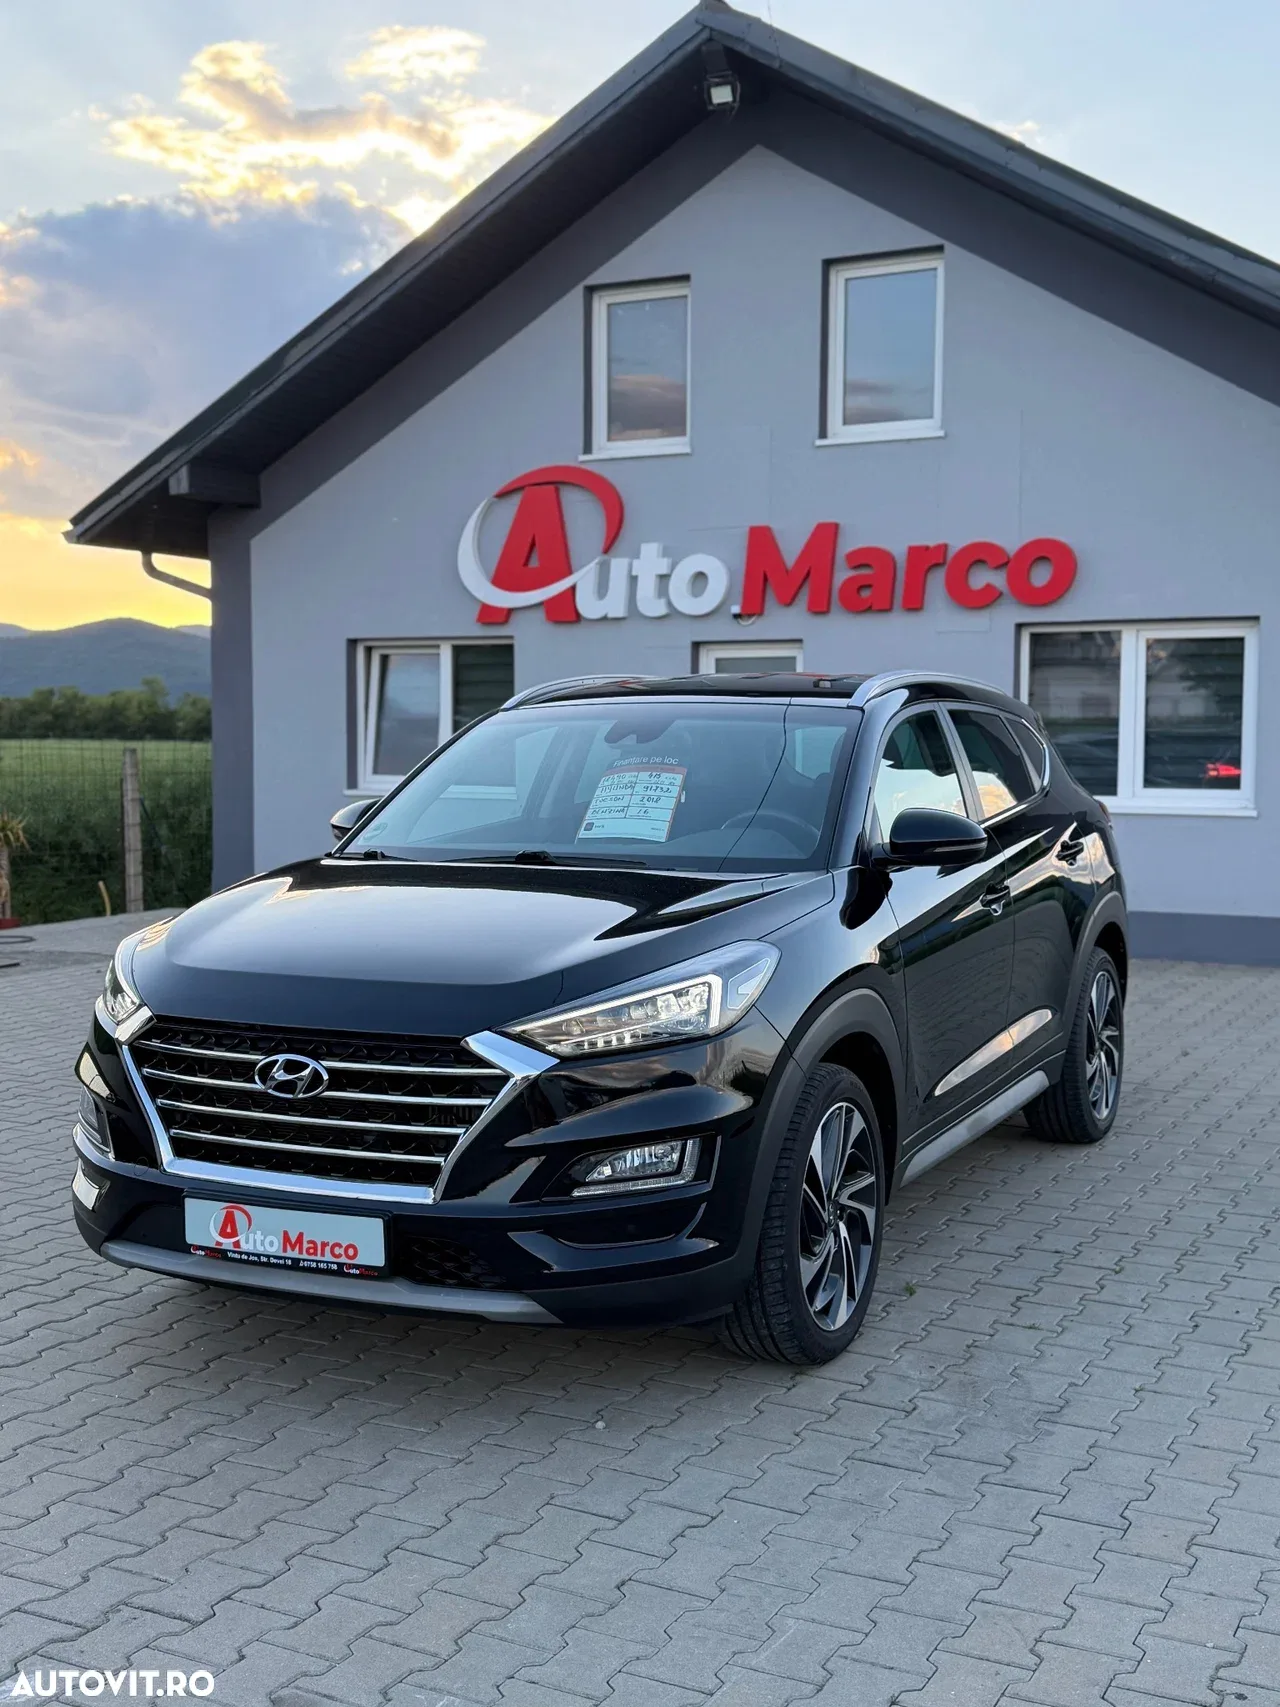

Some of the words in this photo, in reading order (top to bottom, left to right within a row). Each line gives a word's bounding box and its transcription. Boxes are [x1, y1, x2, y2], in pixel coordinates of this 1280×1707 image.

[458, 466, 729, 623] Auto
[739, 522, 1078, 615] Marco
[649, 756, 663, 764] pe
[664, 755, 679, 765] loc
[209, 1203, 279, 1252] Auto
[282, 1229, 359, 1261] Marco
